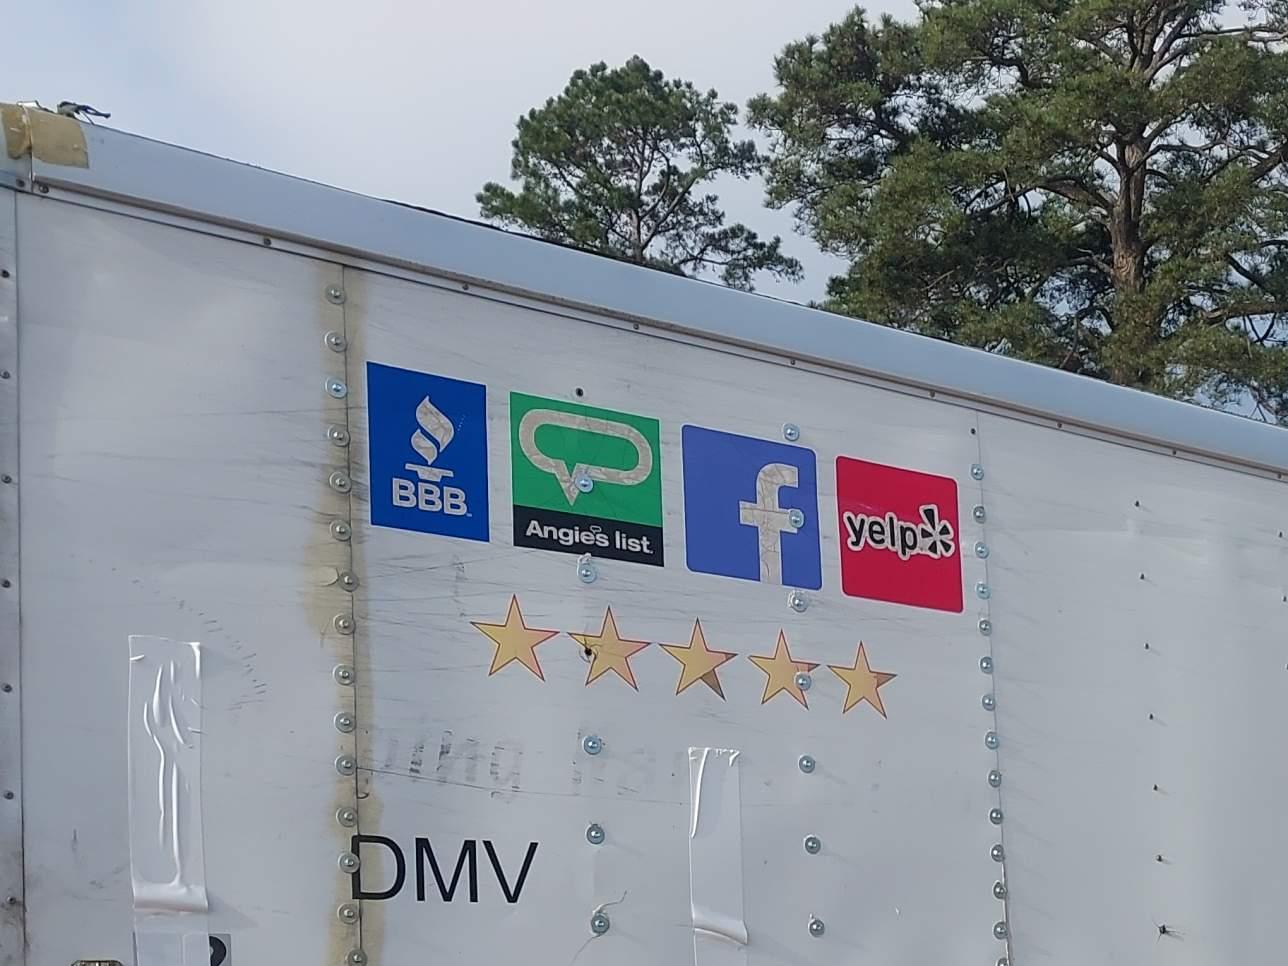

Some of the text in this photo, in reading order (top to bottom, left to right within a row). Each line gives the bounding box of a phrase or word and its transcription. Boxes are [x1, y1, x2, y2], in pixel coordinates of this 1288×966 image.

[391, 477, 469, 517] BBB
[525, 519, 651, 554] Angie's list
[845, 513, 919, 557] yelp
[350, 834, 539, 903] DMV
